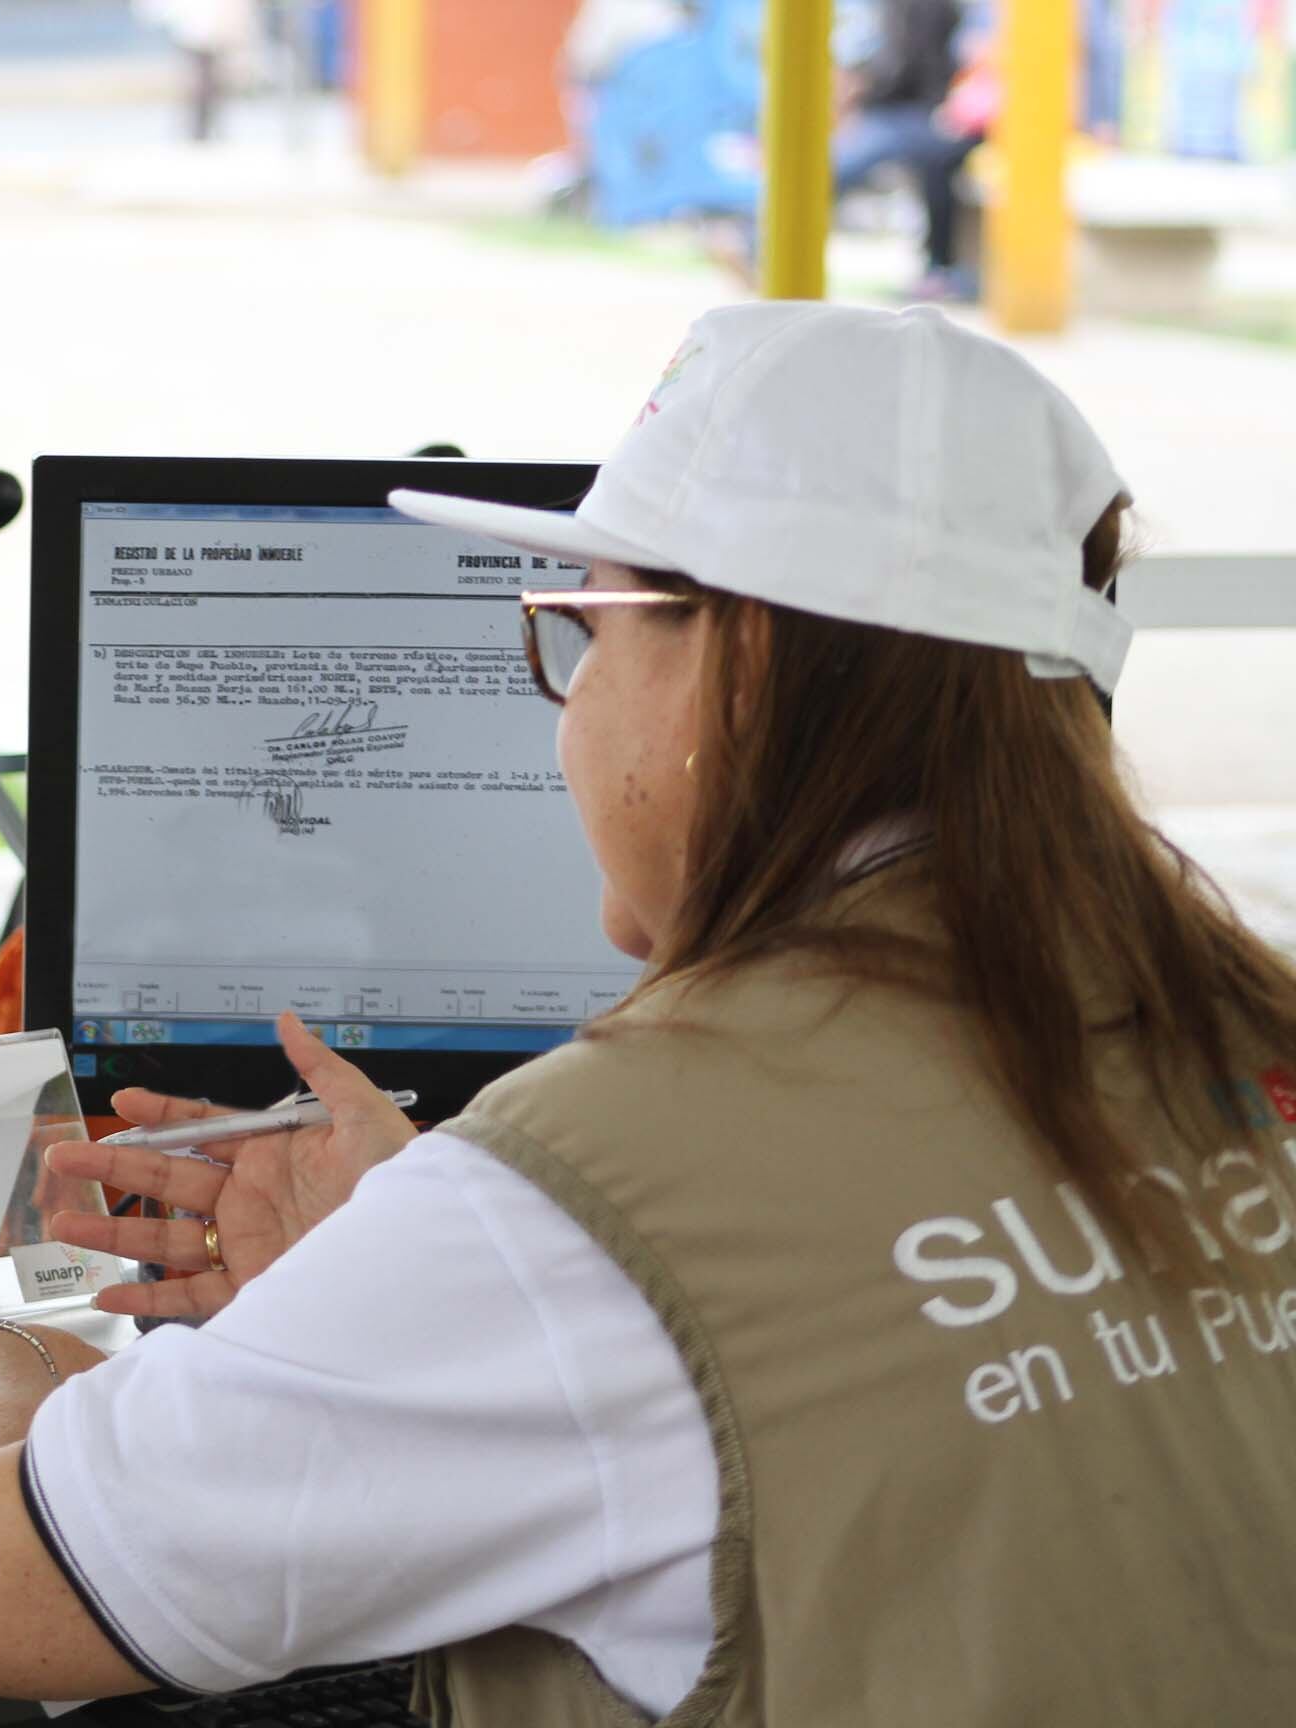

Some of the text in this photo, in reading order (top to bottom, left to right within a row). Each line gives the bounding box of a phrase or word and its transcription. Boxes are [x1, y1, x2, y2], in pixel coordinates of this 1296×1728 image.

[114, 546, 304, 561] REGISTRO DE LA PROPIEDAD INMUEBLE
[457, 555, 522, 569] PROVINCIA
[532, 556, 548, 569] DE
[152, 567, 193, 577] URBANO
[457, 576, 522, 585] DISTRITO DE
[114, 649, 191, 659] DESCRIPCION
[197, 649, 218, 659] DEL
[293, 650, 321, 660] Lote
[328, 651, 342, 660] de
[349, 651, 398, 661] terreno
[155, 661, 170, 670] de
[210, 660, 259, 672] Pueblo,
[265, 662, 329, 673] provincia
[334, 662, 349, 671] de
[513, 662, 529, 672] de
[155, 674, 165, 683] y
[168, 672, 217, 682] medidas
[320, 673, 362, 684] NORTE,
[368, 675, 391, 684] con
[396, 674, 460, 685] propiedad
[465, 674, 480, 684] de
[486, 674, 500, 684] la
[114, 683, 128, 692] de
[258, 685, 280, 694] con
[410, 686, 432, 695] con
[438, 686, 453, 696] el
[148, 695, 170, 704] con
[286, 740, 326, 751] CARLOS
[202, 765, 219, 775] del
[408, 770, 432, 780] para
[464, 782, 476, 791] de
[894, 1138, 1296, 1328] suna
[35, 1264, 84, 1283] sunarp
[964, 1345, 1074, 1423] en
[1091, 1310, 1178, 1384] tu
